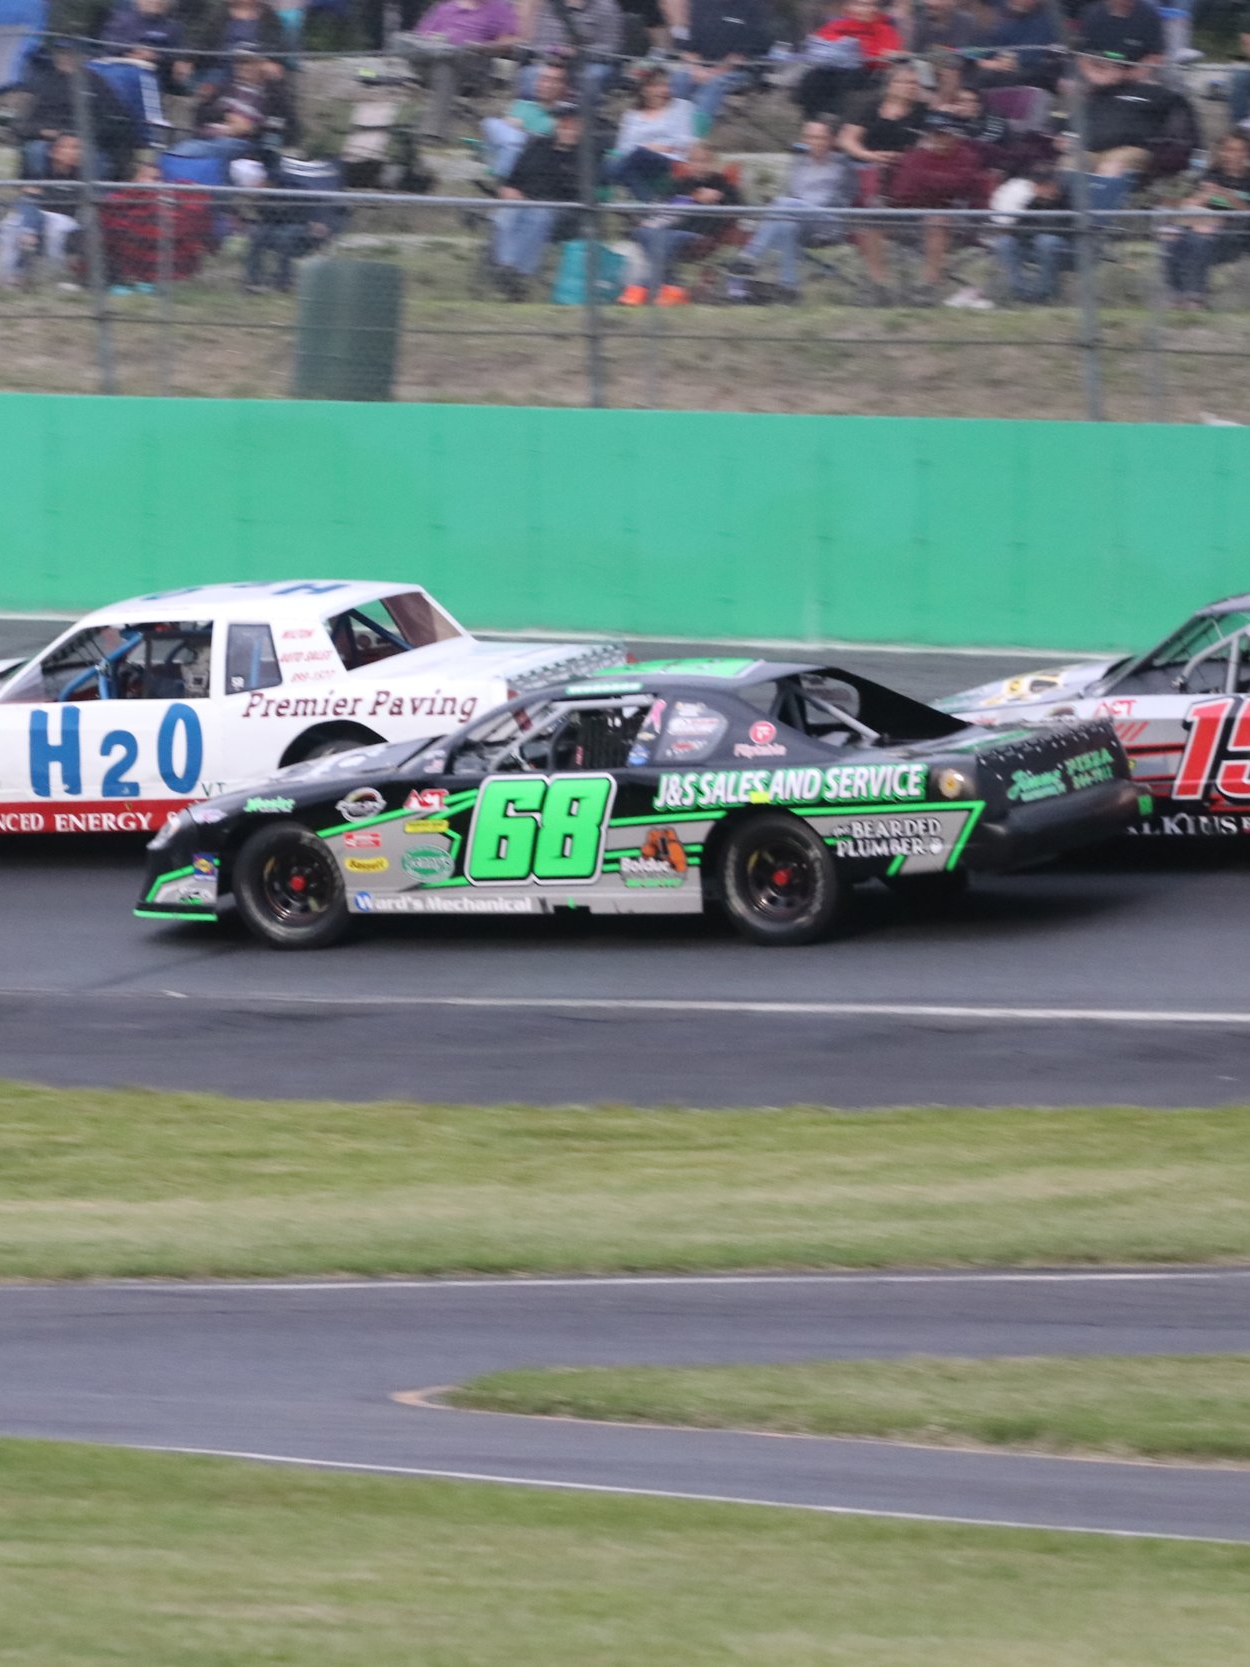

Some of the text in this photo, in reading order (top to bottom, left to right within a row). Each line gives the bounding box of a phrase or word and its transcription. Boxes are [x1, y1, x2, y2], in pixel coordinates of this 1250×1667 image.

[242, 690, 478, 722] Premier Paving
[656, 764, 926, 808] J&S SALES AND SERVICE
[54, 812, 153, 833] ENERGY
[464, 773, 616, 885] 68
[851, 818, 942, 838] BEARDED
[836, 838, 927, 858] PLUMBER
[354, 891, 533, 912] Ward's Mechanical
